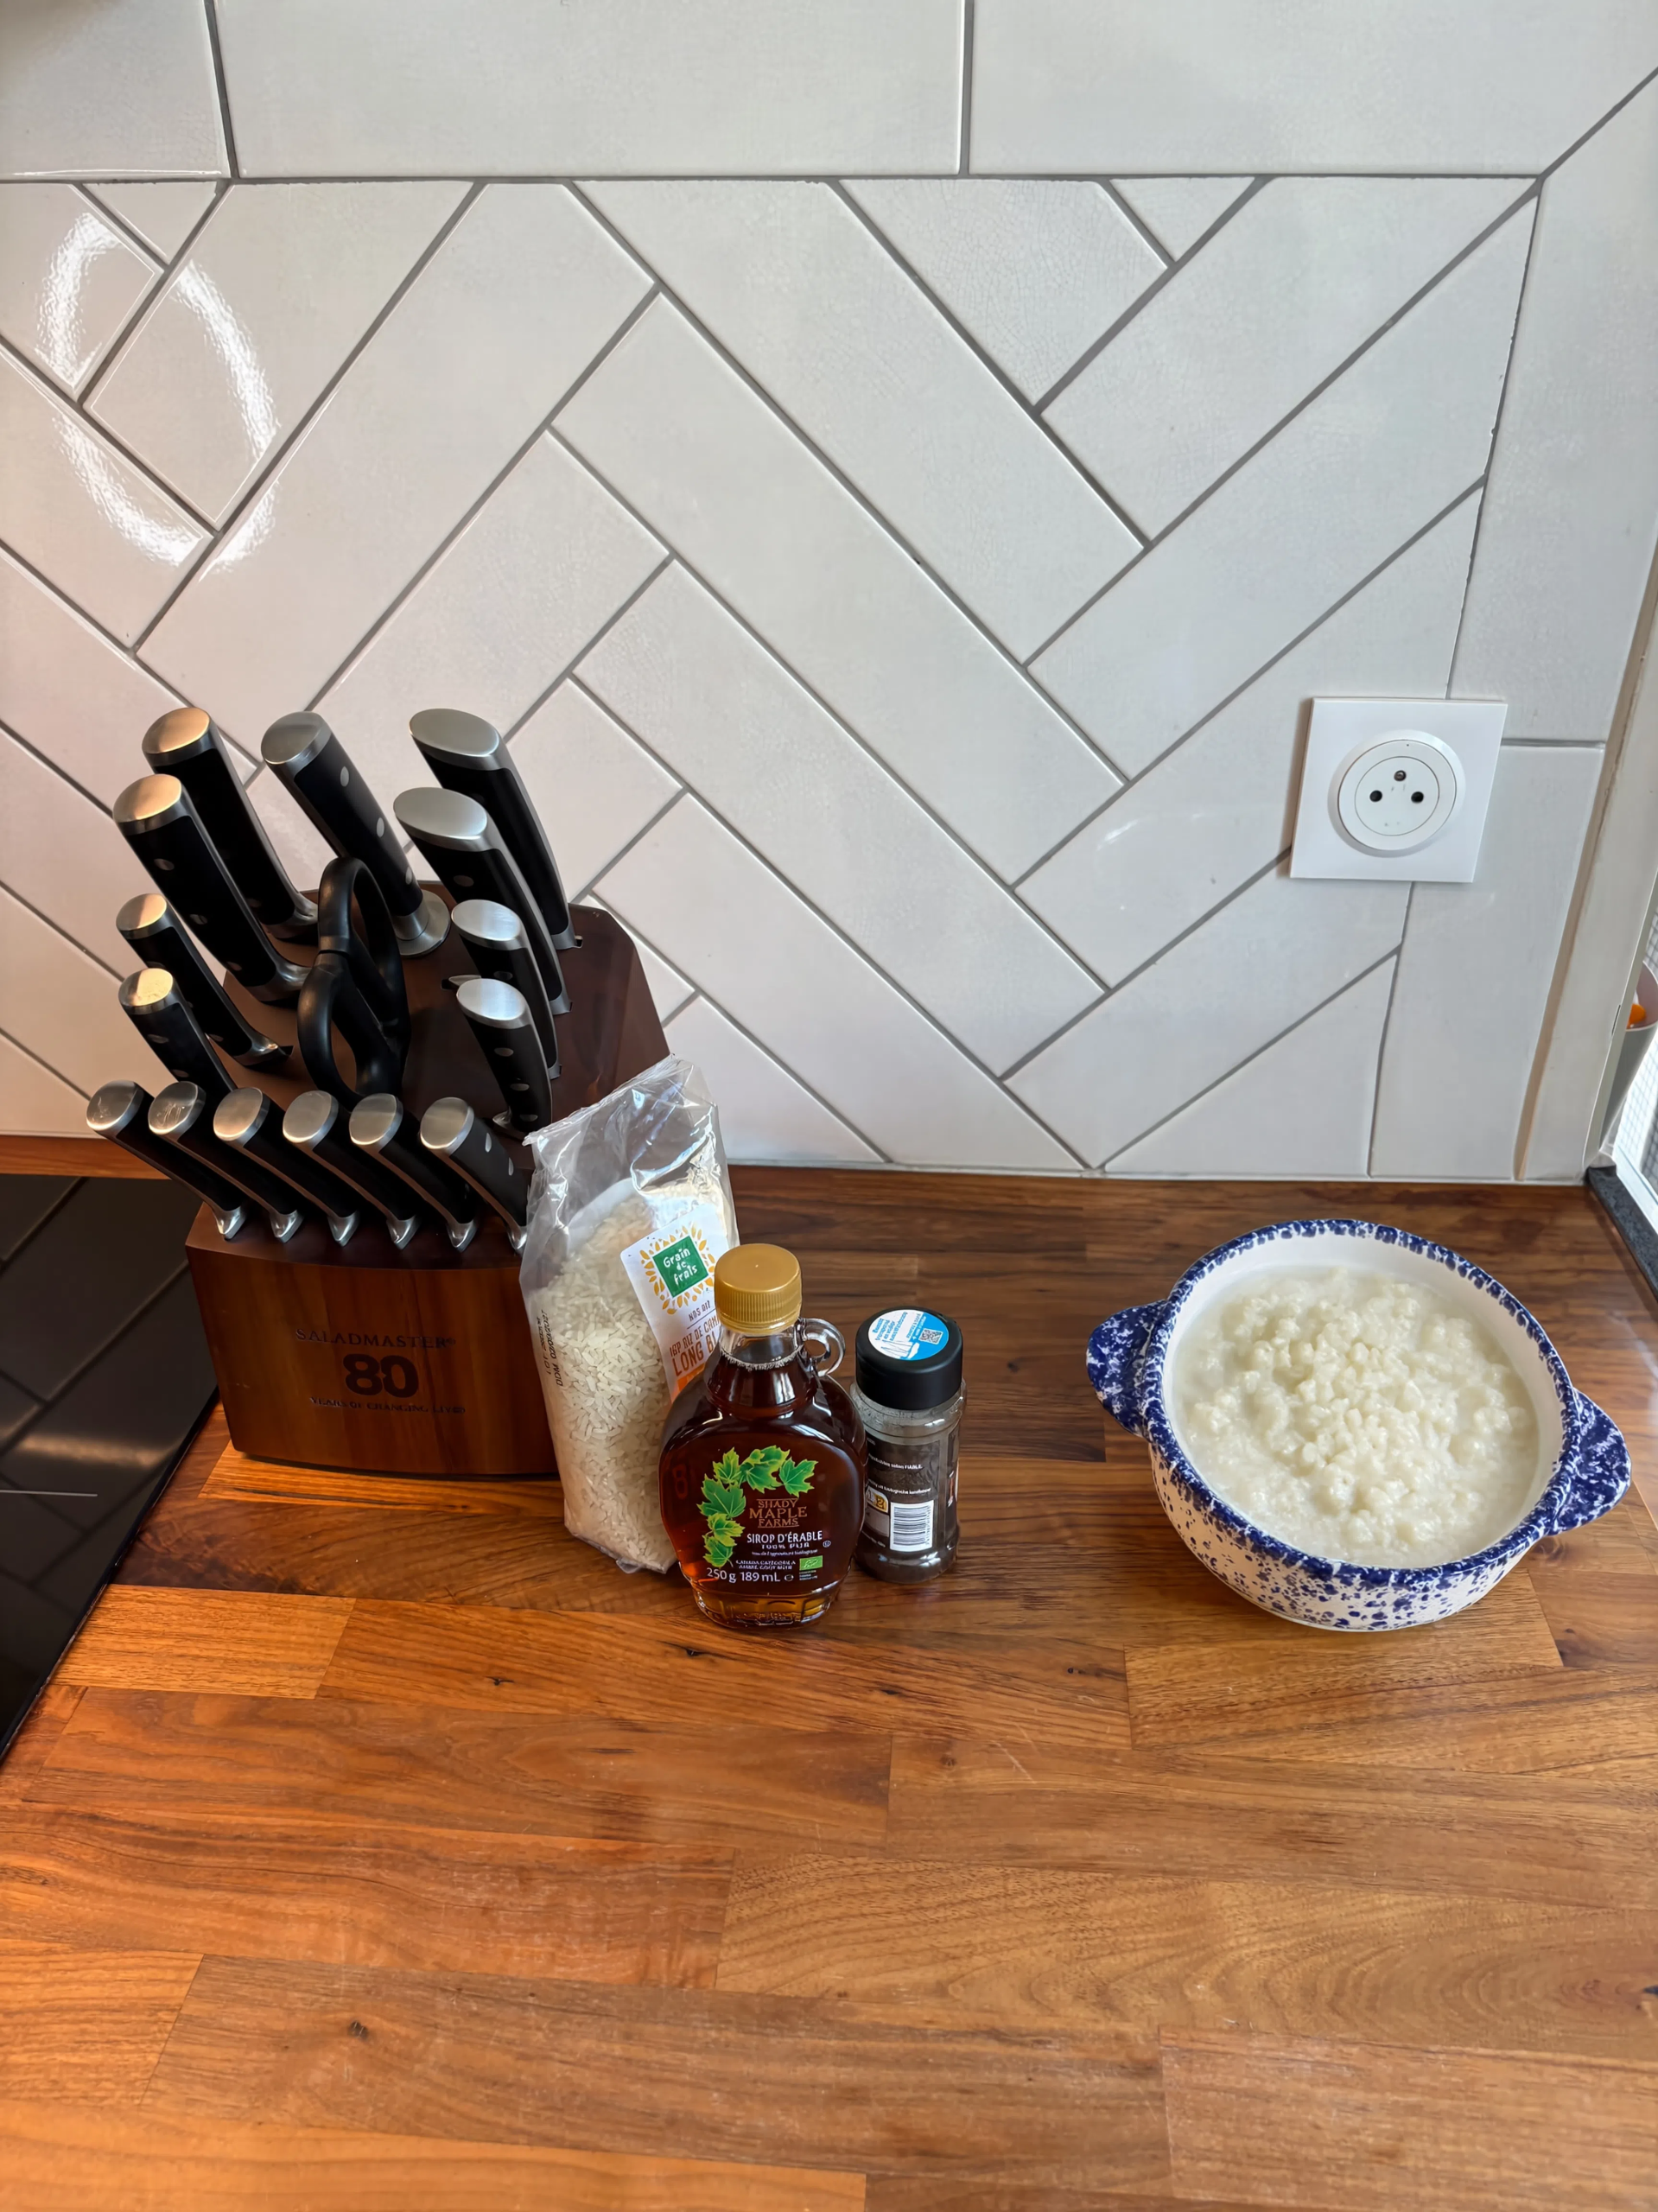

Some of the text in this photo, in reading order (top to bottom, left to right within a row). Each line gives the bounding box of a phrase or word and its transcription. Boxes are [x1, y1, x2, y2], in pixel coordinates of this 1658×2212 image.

[664, 1249, 690, 1268] Grain
[677, 1262, 687, 1270] de
[674, 1265, 697, 1286] frais
[689, 1307, 702, 1321] NOS
[695, 1325, 703, 1340] DE
[672, 1340, 704, 1376] LONG
[343, 1353, 419, 1398] 80
[552, 1363, 563, 1387] DDM
[758, 1498, 798, 1509] SHADY
[749, 1506, 807, 1519] MAPLE
[758, 1518, 798, 1528] FARMS
[746, 1530, 823, 1544] SIROP D'ÉRABLE
[706, 1567, 781, 1584] 250 g 189 mL
